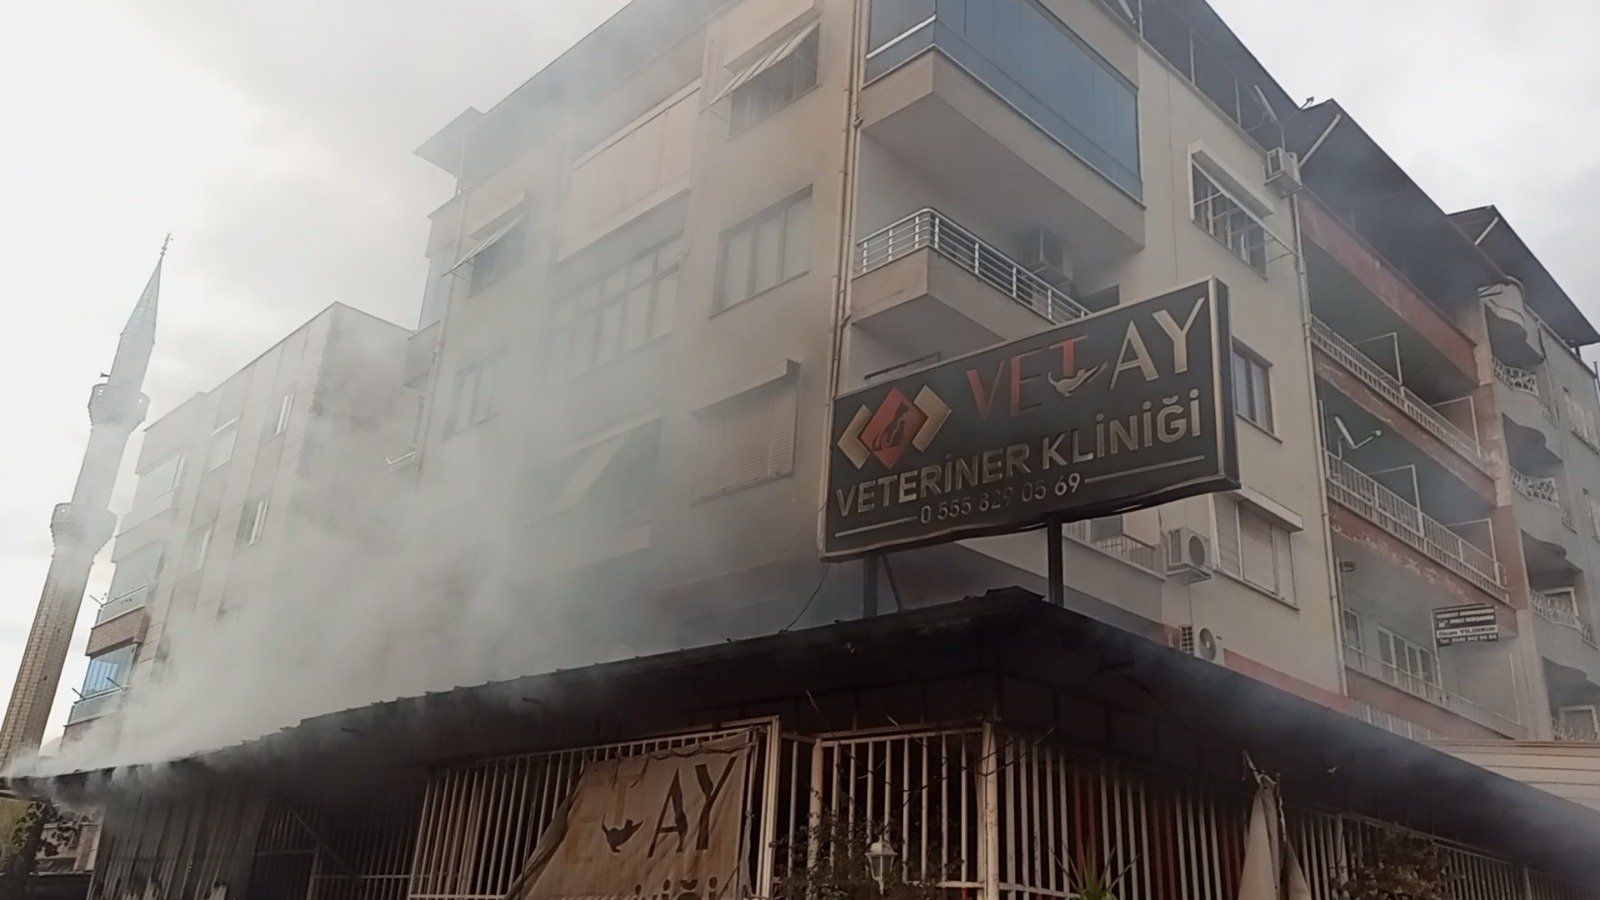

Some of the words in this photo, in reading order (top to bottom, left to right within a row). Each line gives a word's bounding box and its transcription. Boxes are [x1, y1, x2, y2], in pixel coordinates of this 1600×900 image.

[836, 442, 1031, 517] VETERİNER
[1041, 388, 1201, 470] KLİNİĞİ
[920, 505, 932, 524] 0
[937, 496, 972, 521] 555
[1021, 480, 1047, 502] 05
[1054, 472, 1081, 496] 69
